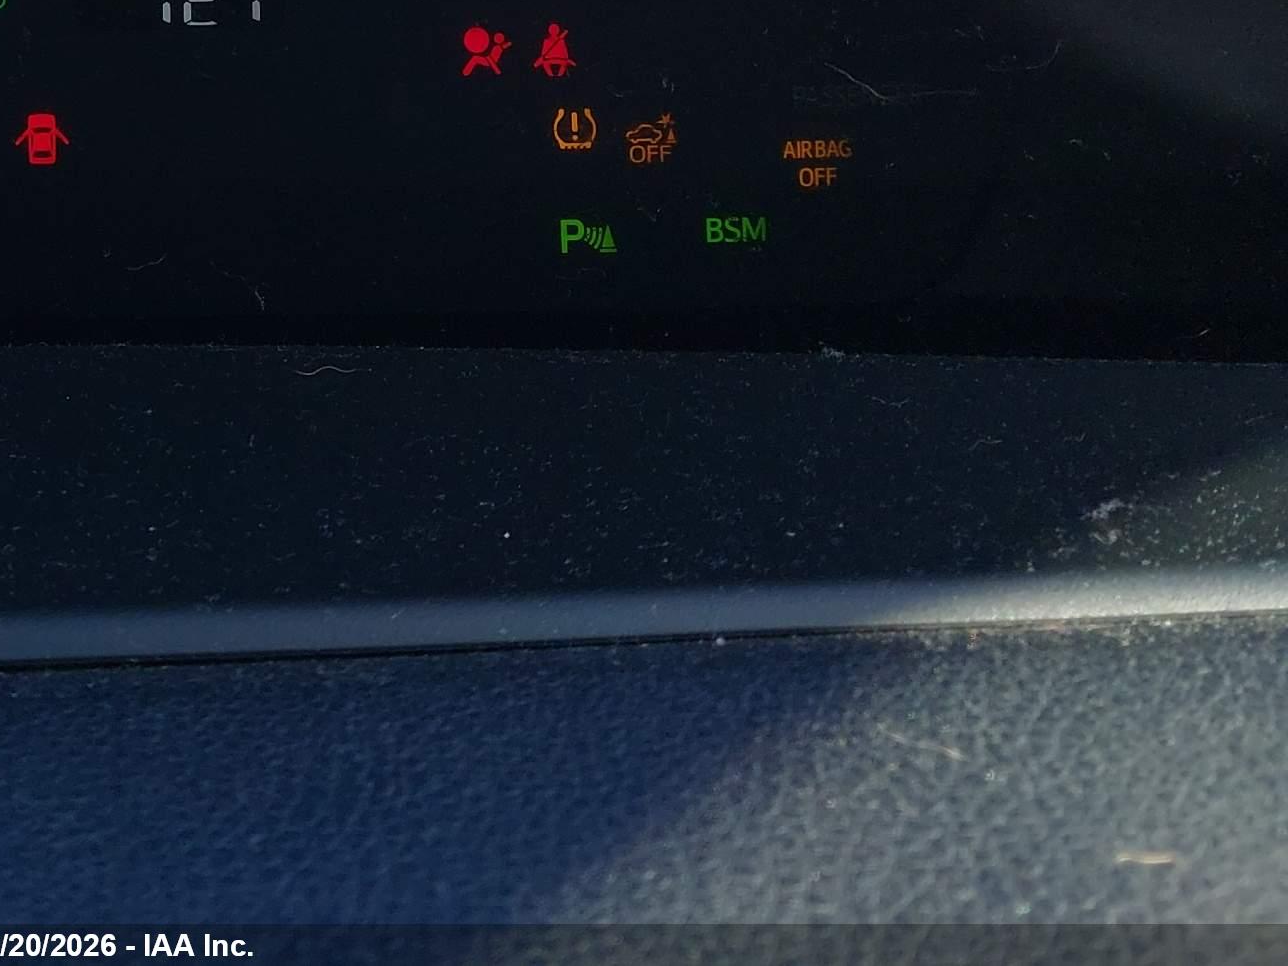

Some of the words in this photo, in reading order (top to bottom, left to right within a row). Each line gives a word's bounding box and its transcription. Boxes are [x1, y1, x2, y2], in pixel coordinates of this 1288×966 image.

[629, 144, 672, 163] OFF
[783, 140, 853, 159] AIRBAG
[799, 167, 838, 188] OFF
[706, 216, 766, 243] BSM
